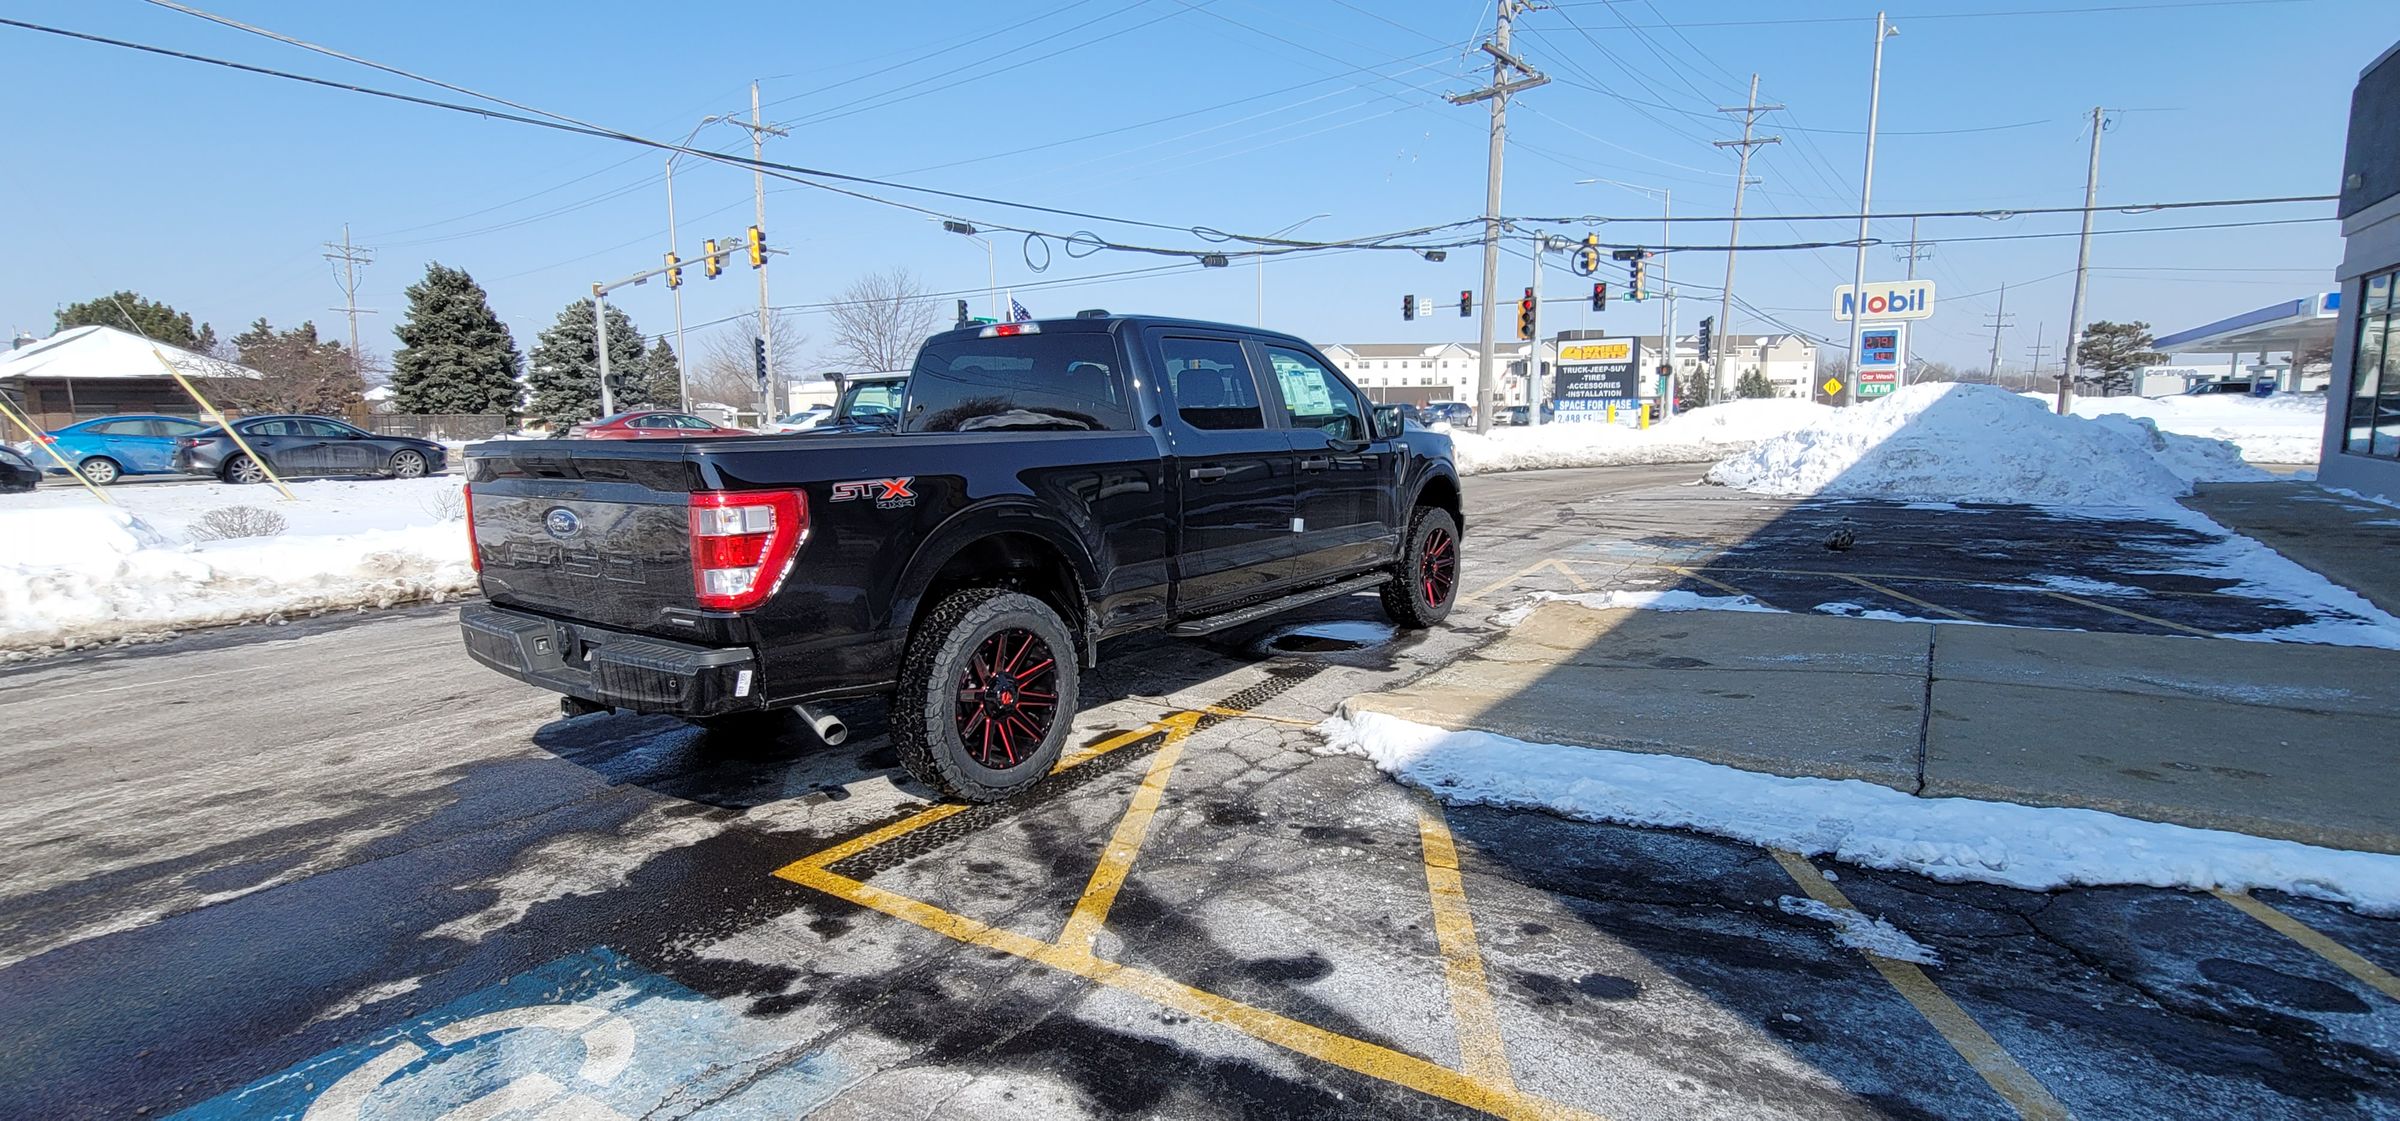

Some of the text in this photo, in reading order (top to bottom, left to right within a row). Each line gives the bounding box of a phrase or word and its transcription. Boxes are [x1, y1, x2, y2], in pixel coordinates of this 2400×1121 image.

[1842, 289, 1924, 315] Mobil
[1864, 384, 1891, 393] ATM
[1559, 400, 1586, 410] SPACE
[1587, 400, 1604, 410] FOR
[829, 476, 918, 502] STX
